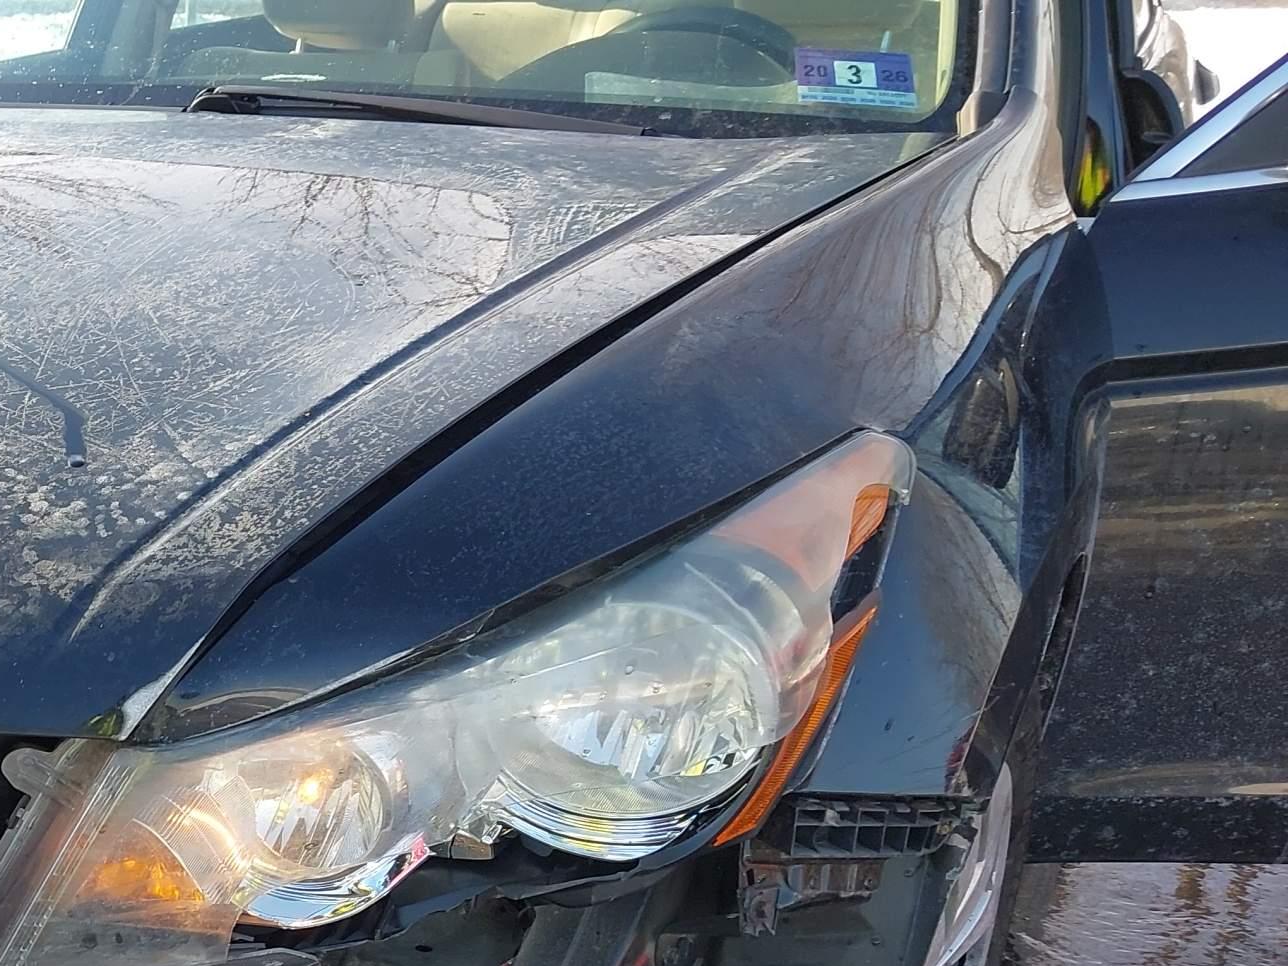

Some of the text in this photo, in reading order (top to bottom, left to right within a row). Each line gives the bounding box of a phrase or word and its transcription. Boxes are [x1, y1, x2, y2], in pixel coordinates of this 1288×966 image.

[804, 65, 909, 84] 20 3 26
